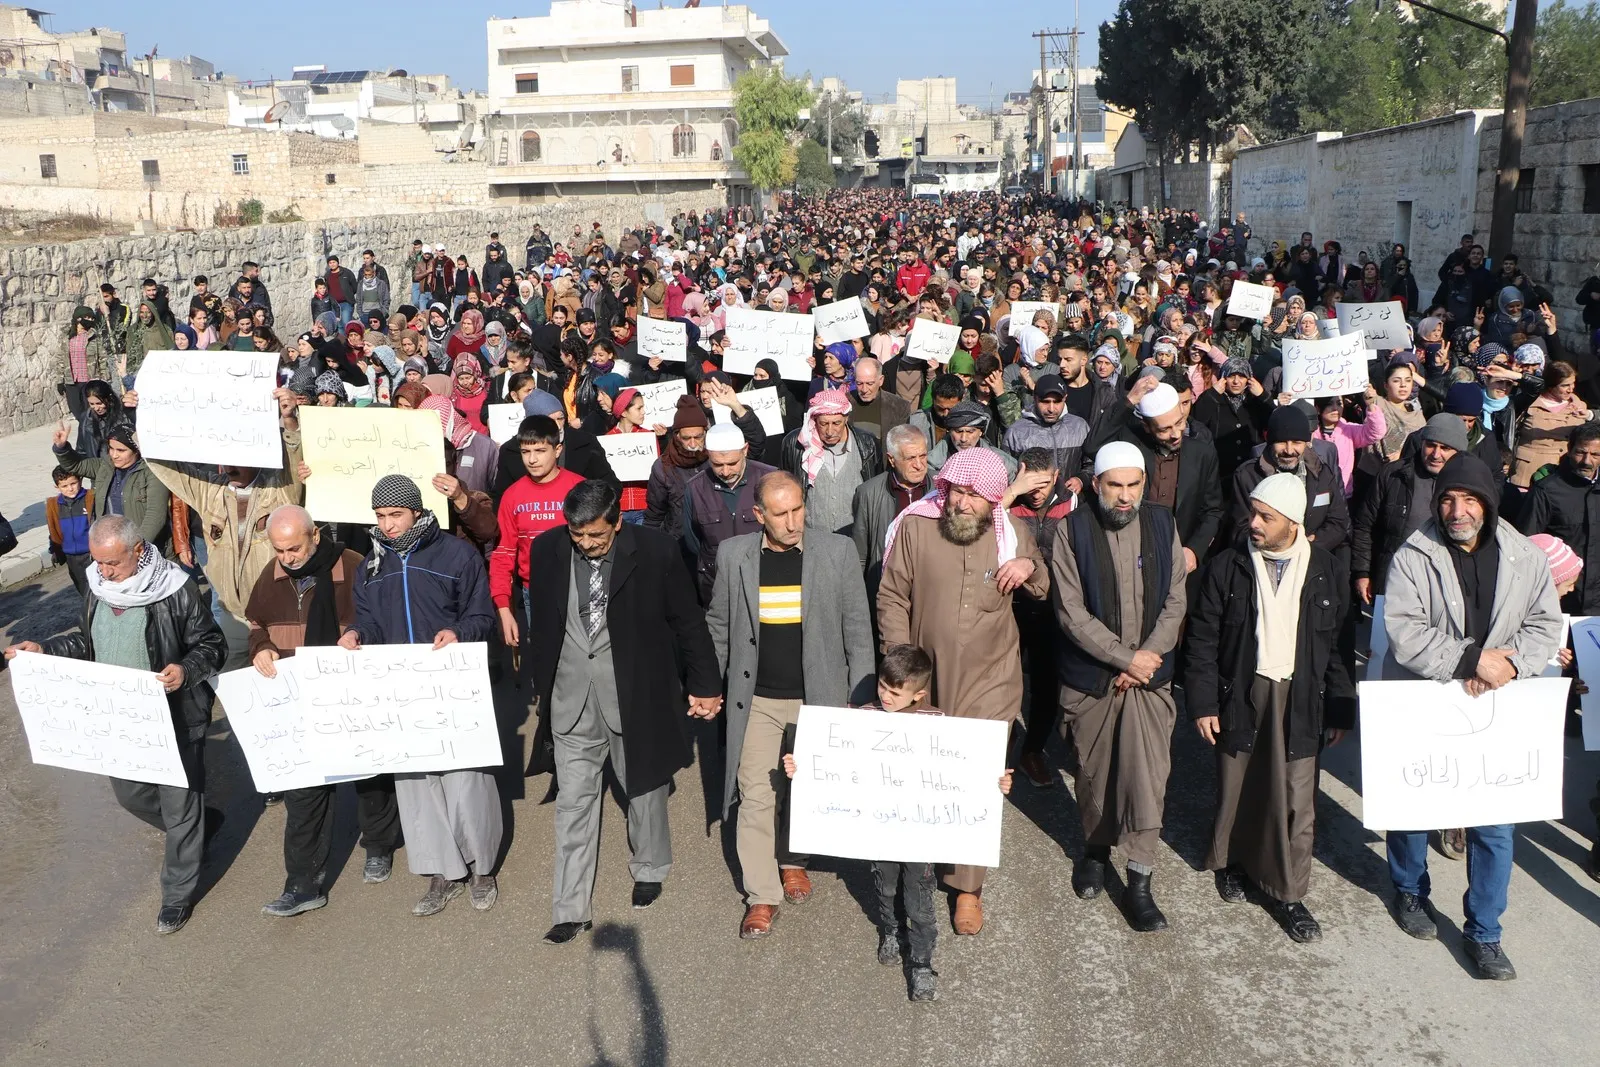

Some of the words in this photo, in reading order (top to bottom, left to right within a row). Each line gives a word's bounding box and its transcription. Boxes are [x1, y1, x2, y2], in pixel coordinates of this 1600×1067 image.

[1349, 306, 1373, 327] نركع
[1380, 306, 1391, 320] لن
[1287, 345, 1301, 363] في
[226, 360, 272, 385] نطالب
[342, 423, 382, 449] النفس
[392, 423, 430, 452] حماية
[333, 454, 377, 480] الحرية
[386, 457, 424, 480] مفاح
[530, 512, 556, 521] PUSH
[543, 501, 565, 511] LIM
[304, 654, 357, 681] التنقل
[363, 657, 410, 680] بحرية
[412, 652, 481, 678] نطالب
[118, 677, 162, 698] نطالب
[311, 687, 363, 713] حلب
[313, 711, 404, 739] المحافظات
[828, 722, 855, 749] Em
[871, 729, 914, 755] Zarok
[354, 739, 456, 767] السورية
[812, 754, 841, 782] Em
[880, 762, 905, 788] Her
[920, 769, 966, 793] Hebin.
[1402, 754, 1460, 789] الخانق
[1467, 748, 1540, 790] للحصار
